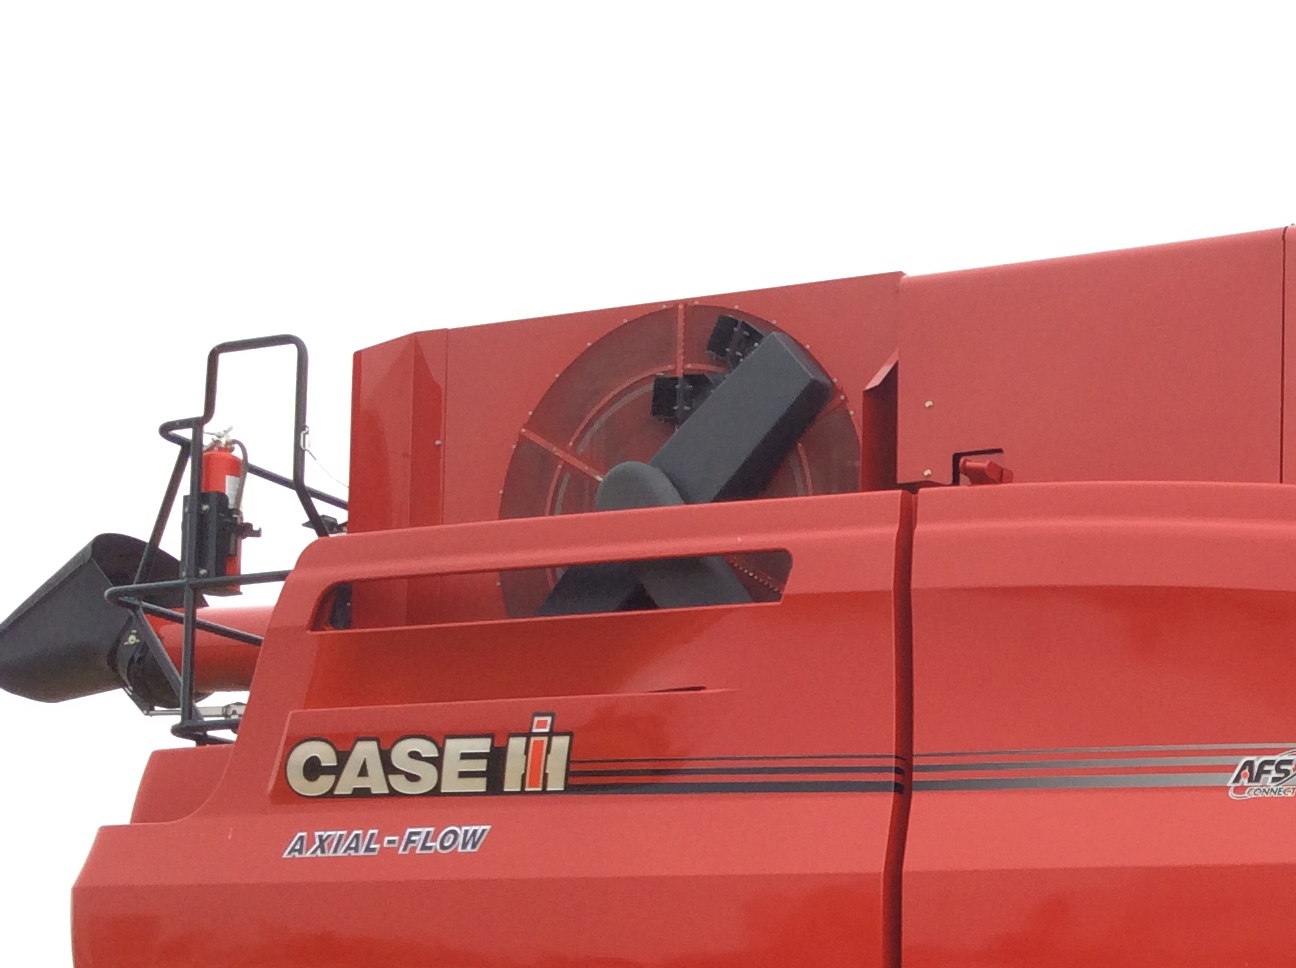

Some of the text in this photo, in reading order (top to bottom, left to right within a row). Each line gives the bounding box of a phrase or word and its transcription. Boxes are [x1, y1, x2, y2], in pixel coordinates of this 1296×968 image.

[286, 737, 493, 796] CASE
[1229, 756, 1296, 785] AFS
[1247, 787, 1296, 796] CONNECT
[283, 825, 491, 858] AXIAL-FLOW
